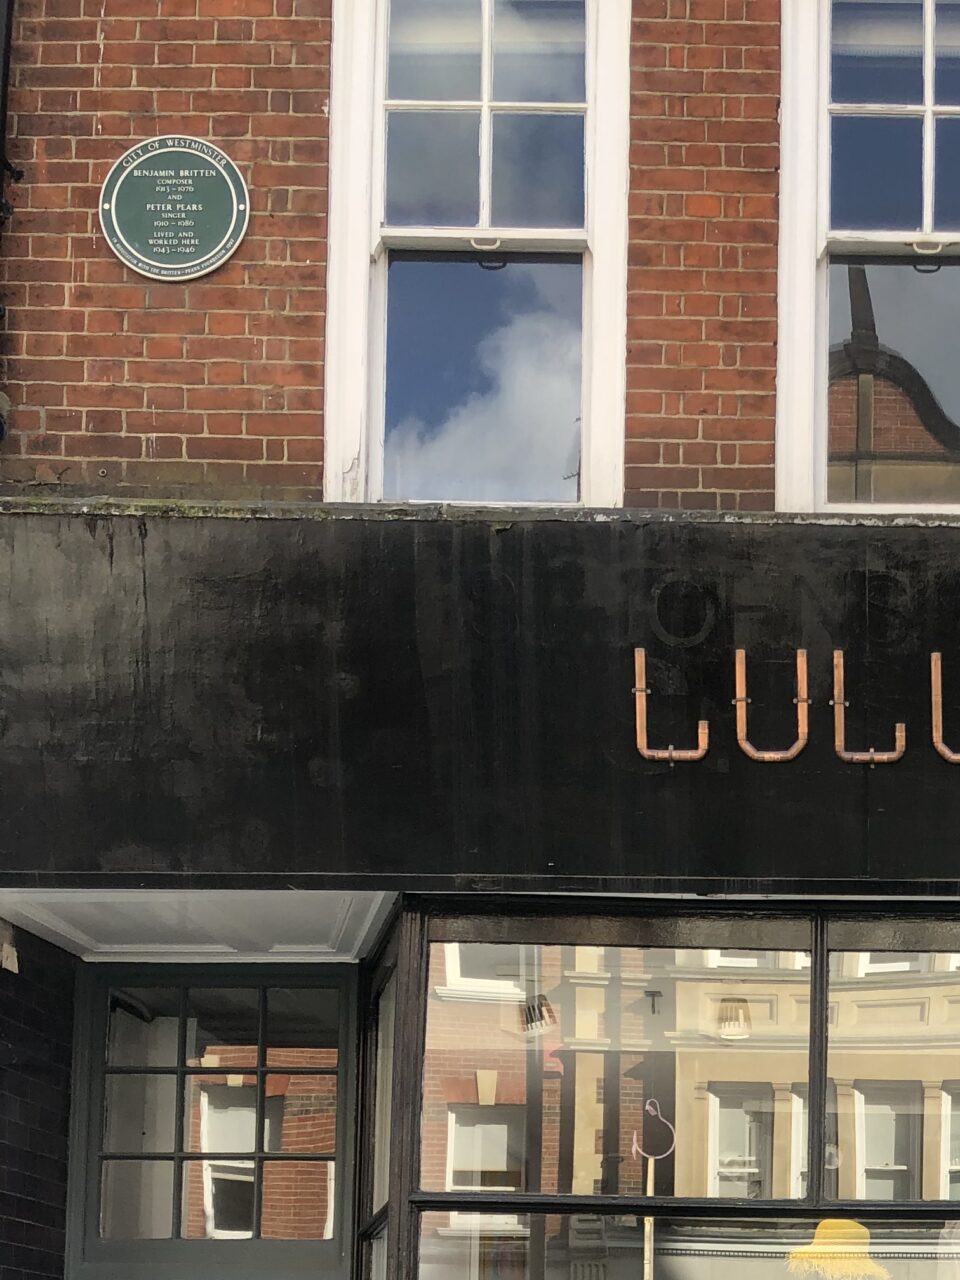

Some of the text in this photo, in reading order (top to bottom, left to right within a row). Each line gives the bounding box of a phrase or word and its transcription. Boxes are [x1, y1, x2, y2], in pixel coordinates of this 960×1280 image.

[122, 139, 227, 168] CITY OF WESTMINSTER
[133, 169, 216, 177] BENJAMIN BRITTEN
